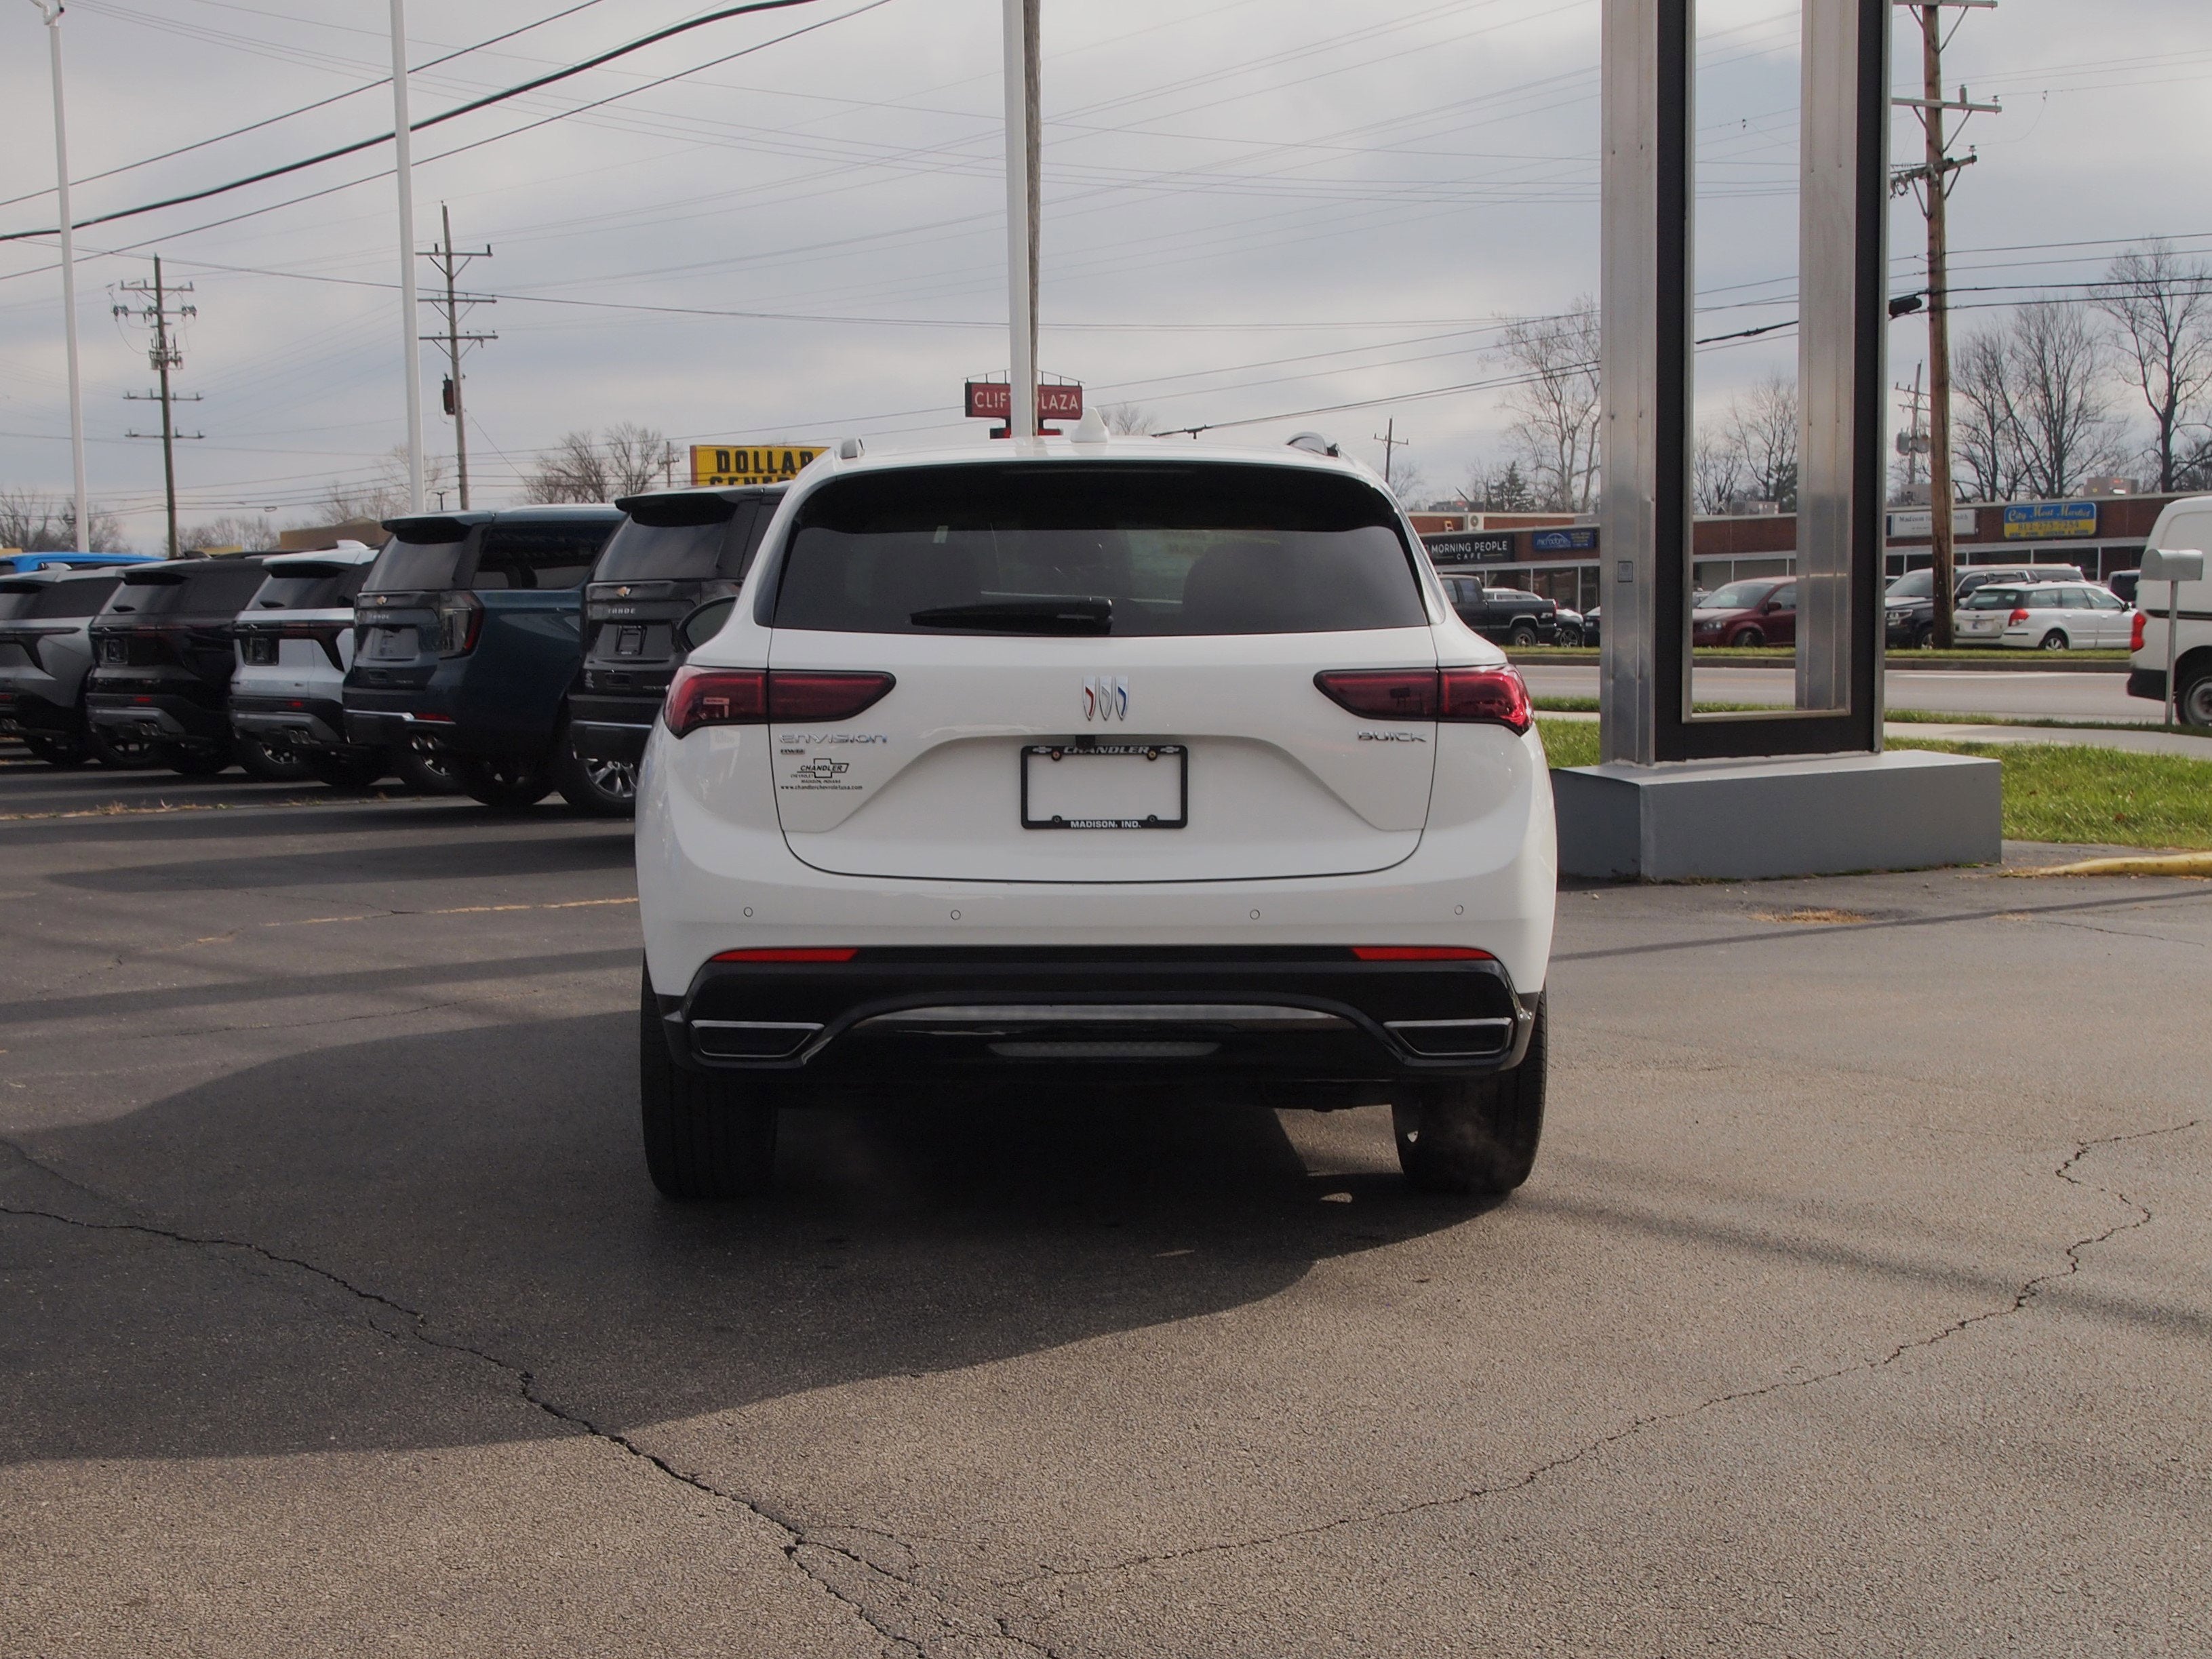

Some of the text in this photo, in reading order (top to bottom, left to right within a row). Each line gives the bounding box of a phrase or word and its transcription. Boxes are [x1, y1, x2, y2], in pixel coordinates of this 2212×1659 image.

[974, 391, 1078, 410] CLIF LAZA
[1431, 543, 1472, 554] MORNING
[1474, 540, 1507, 551] PEOPLE
[781, 734, 887, 744] ENVISION
[1358, 731, 1426, 742] BUICK
